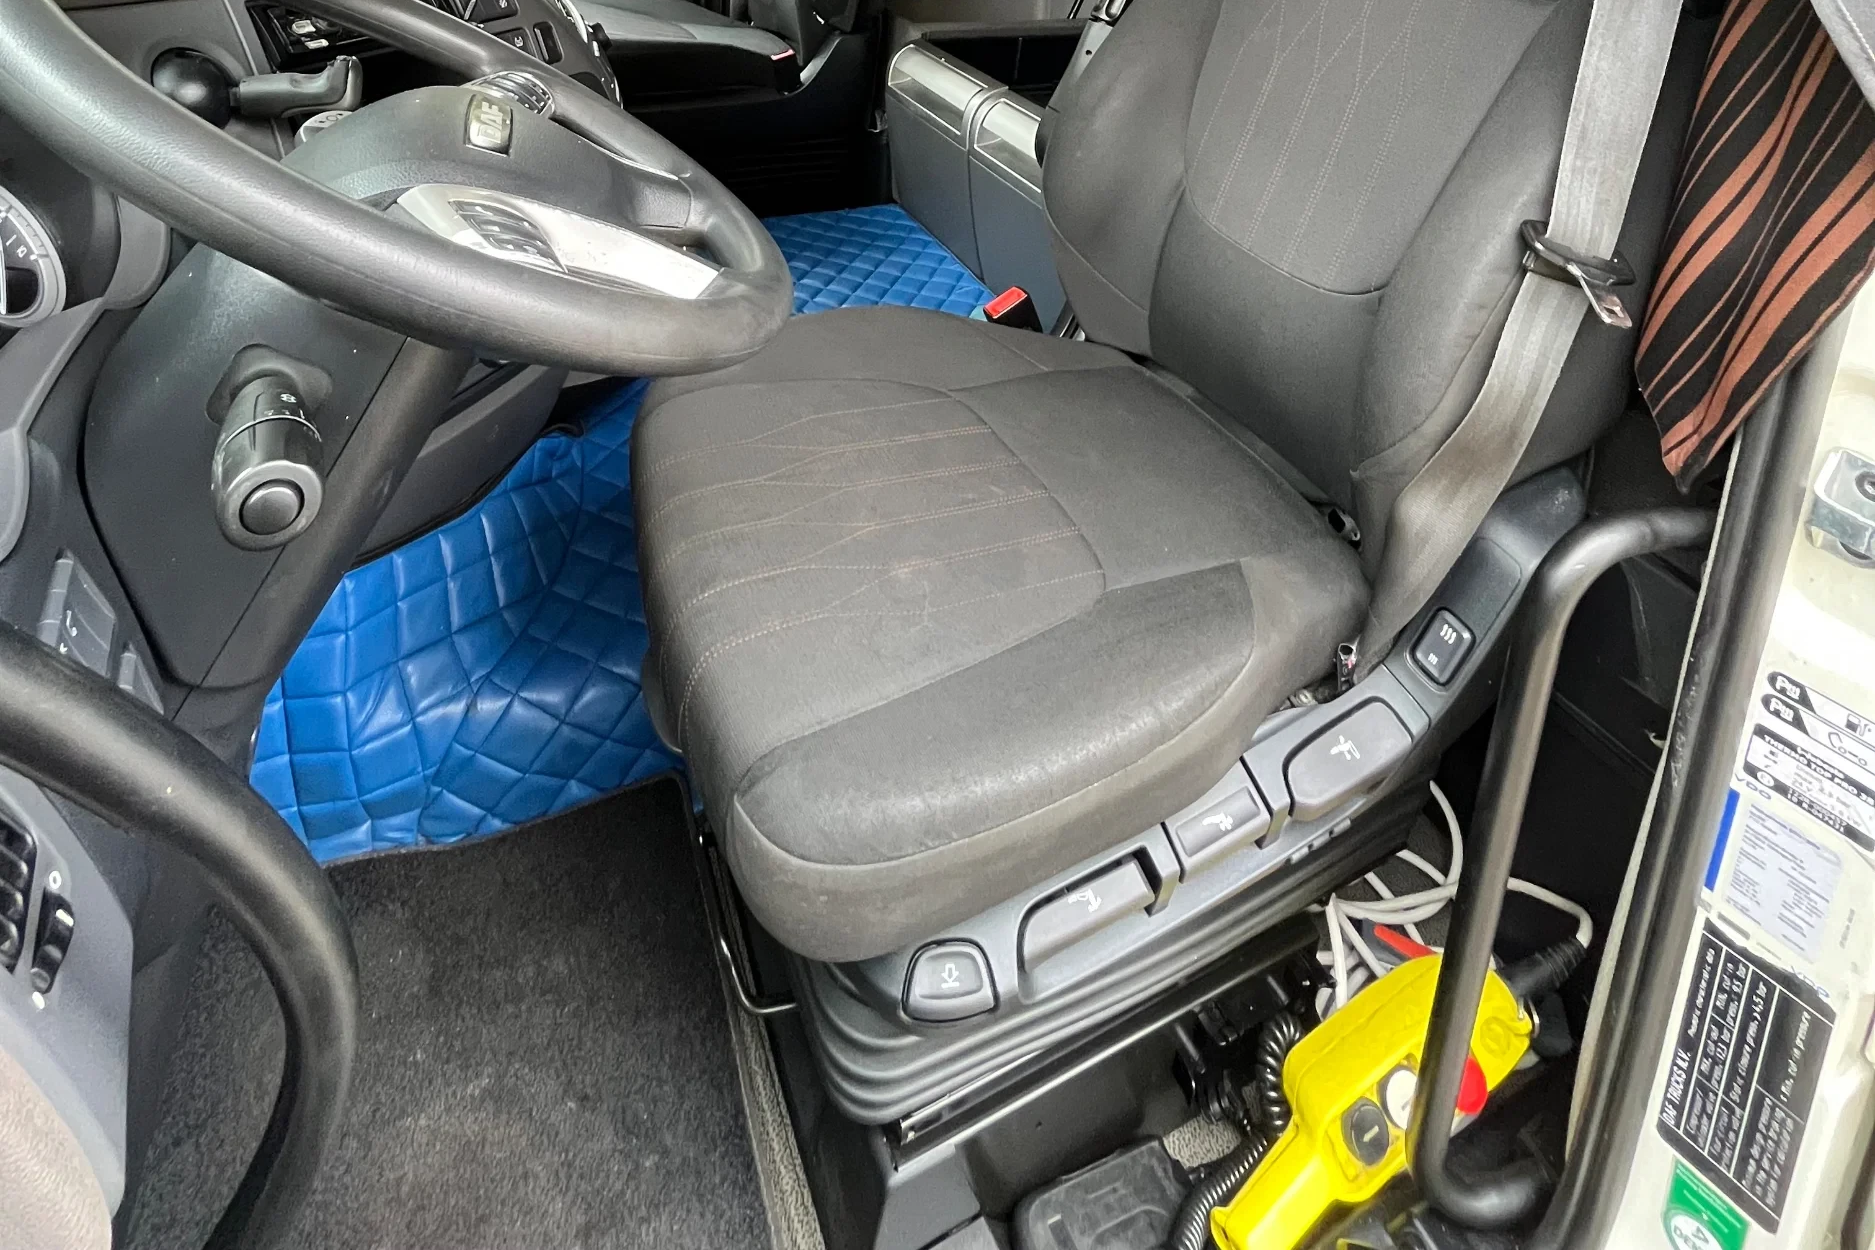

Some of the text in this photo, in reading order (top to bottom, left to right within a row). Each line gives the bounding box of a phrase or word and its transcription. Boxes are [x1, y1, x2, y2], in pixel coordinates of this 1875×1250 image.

[481, 101, 503, 143] DAF
[1735, 773, 1771, 800] VDO
[1810, 763, 1832, 778] TOP
[1833, 777, 1858, 795] PRO
[1737, 962, 1747, 979] bar
[1756, 980, 1767, 998] bar
[1721, 1025, 1732, 1043] bar
[1667, 1064, 1686, 1106] TRUCKS
[1662, 1100, 1677, 1125] DAF
